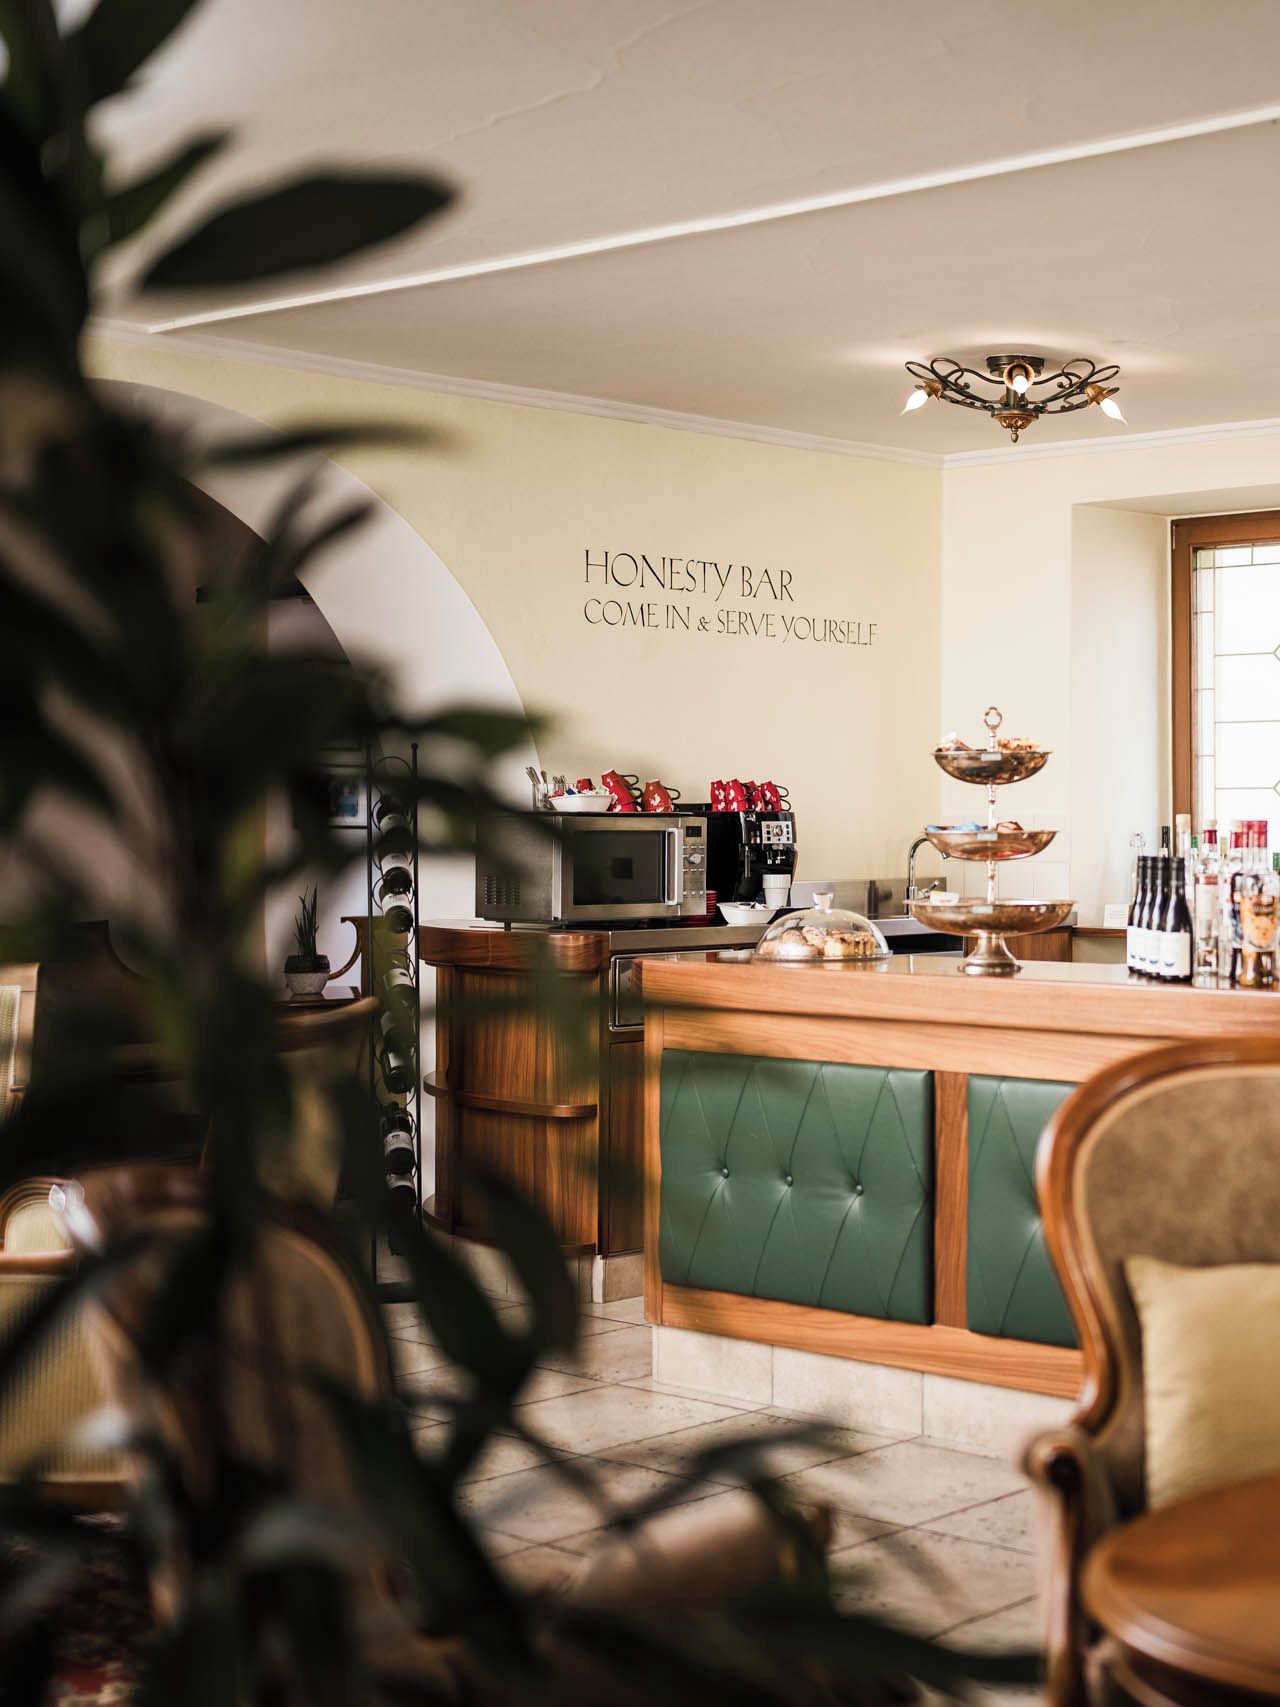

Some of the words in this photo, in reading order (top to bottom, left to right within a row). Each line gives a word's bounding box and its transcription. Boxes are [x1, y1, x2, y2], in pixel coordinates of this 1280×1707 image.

[584, 549, 733, 602] HONESTY
[740, 565, 794, 602] BAR
[584, 598, 659, 628] COME
[665, 604, 691, 630] IN
[697, 616, 711, 632] &
[717, 609, 776, 637] SERVE
[781, 615, 878, 646] YOURSELF
